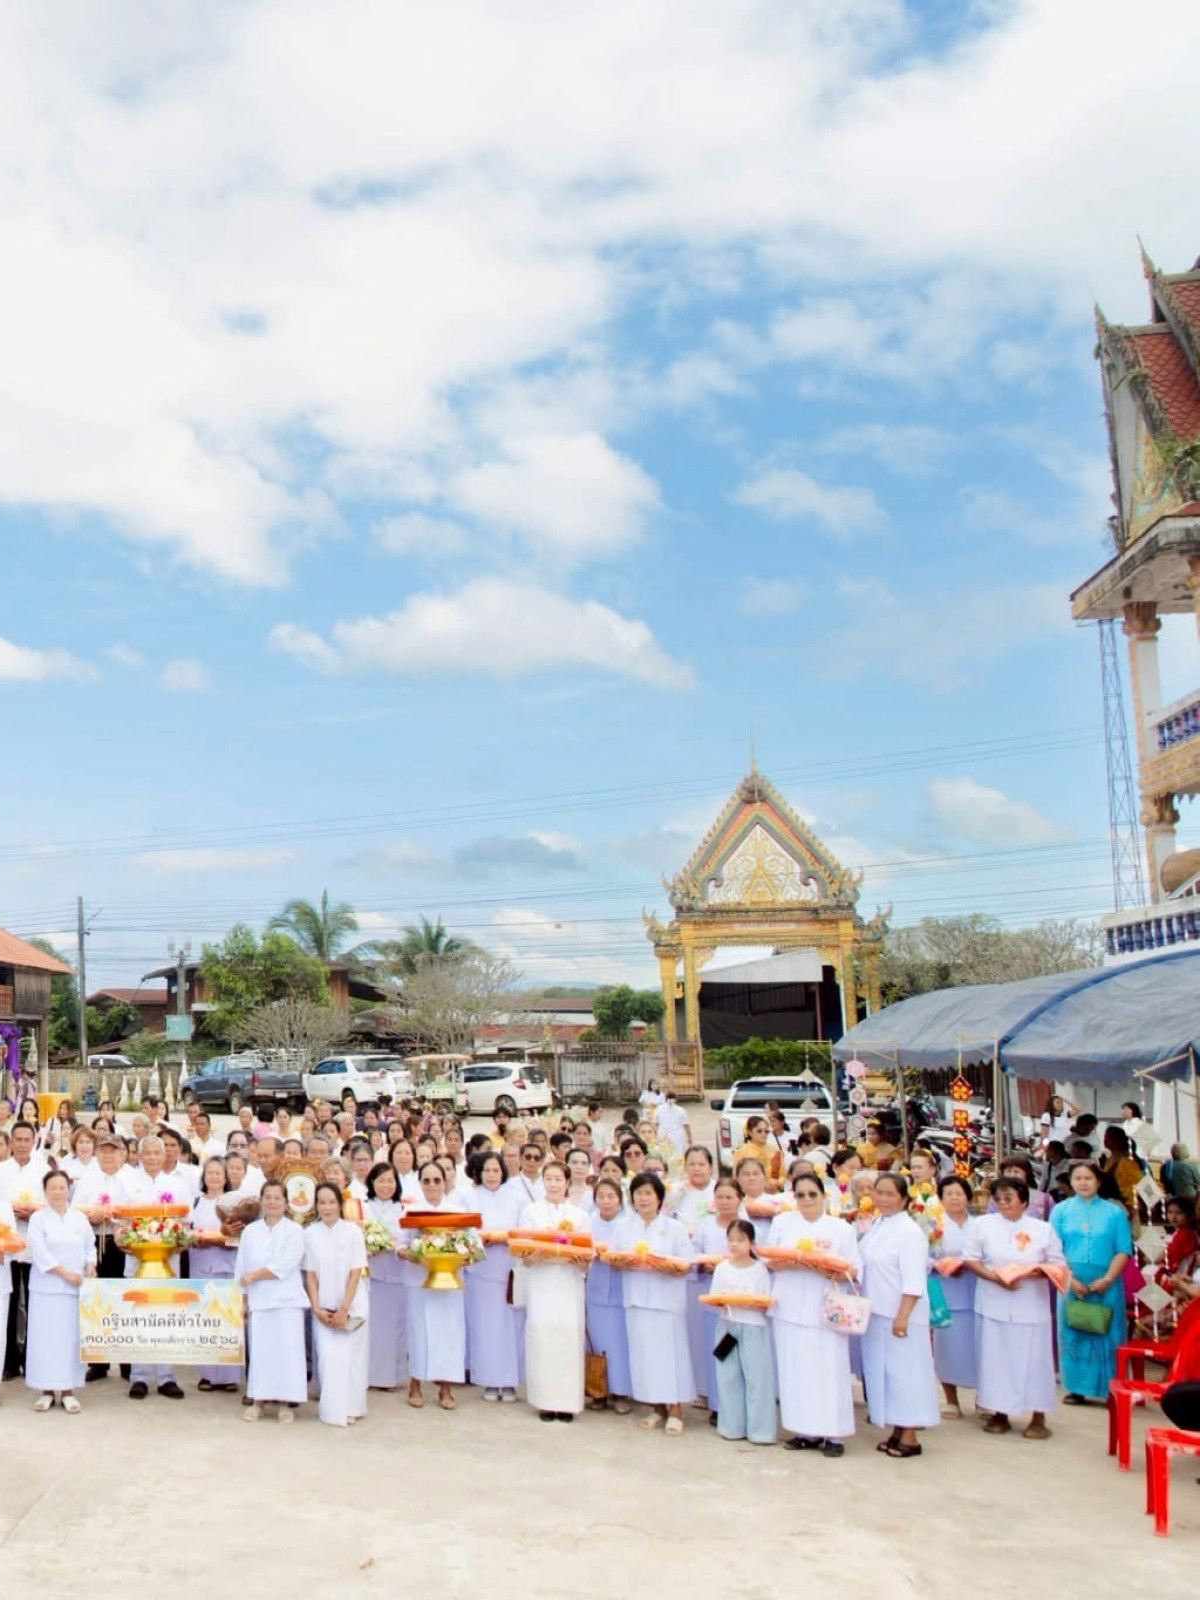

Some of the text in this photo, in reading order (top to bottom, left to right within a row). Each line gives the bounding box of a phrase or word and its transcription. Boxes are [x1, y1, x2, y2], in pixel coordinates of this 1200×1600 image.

[102, 1310, 221, 1330] กฐินสามัคคีทั่วไทย
